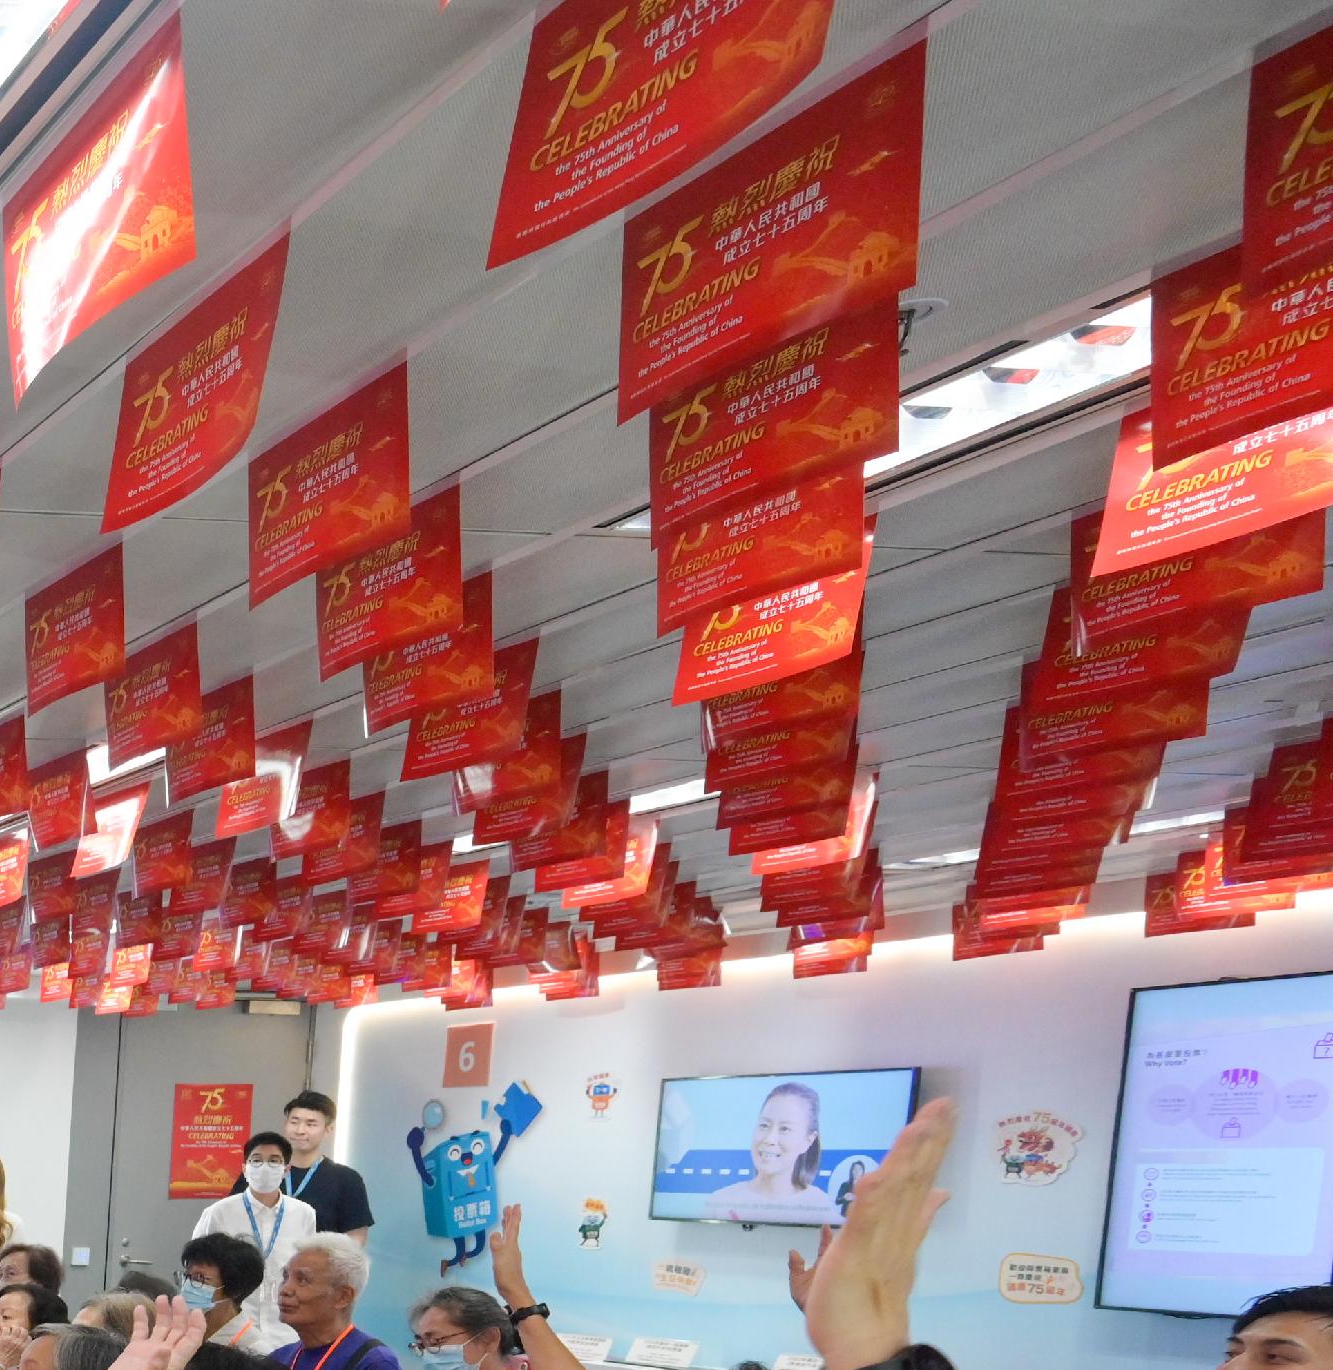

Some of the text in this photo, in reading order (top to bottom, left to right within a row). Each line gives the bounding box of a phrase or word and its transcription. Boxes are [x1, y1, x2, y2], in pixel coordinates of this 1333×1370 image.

[547, 6, 630, 140] 75
[529, 48, 700, 172] CELEBRATING
[555, 98, 668, 177] the 75th Anniversary of
[533, 196, 551, 213] the
[596, 150, 638, 182] Republic
[639, 140, 650, 156] of
[651, 123, 680, 148] China
[571, 127, 648, 181] the Founding of
[709, 133, 841, 236] 熱烈慶祝
[714, 181, 821, 253] 中華人民共和國
[723, 195, 829, 266] 成立七十五周年
[637, 214, 705, 318] 75
[633, 256, 761, 344] CELEBRATING
[678, 302, 724, 337] Anniversary
[721, 313, 744, 334] China
[1170, 282, 1244, 372] 75
[178, 306, 249, 380] 熱烈慶祝
[673, 321, 708, 349] Founding
[721, 327, 829, 400] 熱烈慶祝
[1167, 317, 1332, 397] CELEBRATING
[133, 366, 174, 449] 75
[726, 364, 815, 414] 中華人民共和國
[734, 376, 821, 426] 成立七十五周年
[125, 403, 209, 470] CELEBRATING
[295, 420, 365, 478] 熱烈慶祝
[660, 421, 766, 485] CELEBRATING
[662, 382, 718, 463] 75
[256, 463, 292, 533] 75
[1125, 449, 1273, 512] CELEBRATING
[254, 502, 323, 552] CELEBRATING
[665, 534, 755, 582] CELEBRATING
[323, 597, 385, 634] CELEBRATING
[324, 562, 355, 617] 75
[693, 618, 784, 657] CELEBRATING
[458, 1041, 476, 1073] 6
[199, 1088, 225, 1113] 75
[188, 1132, 234, 1140] CELEBRATING
[454, 1200, 491, 1222] 投票箱
